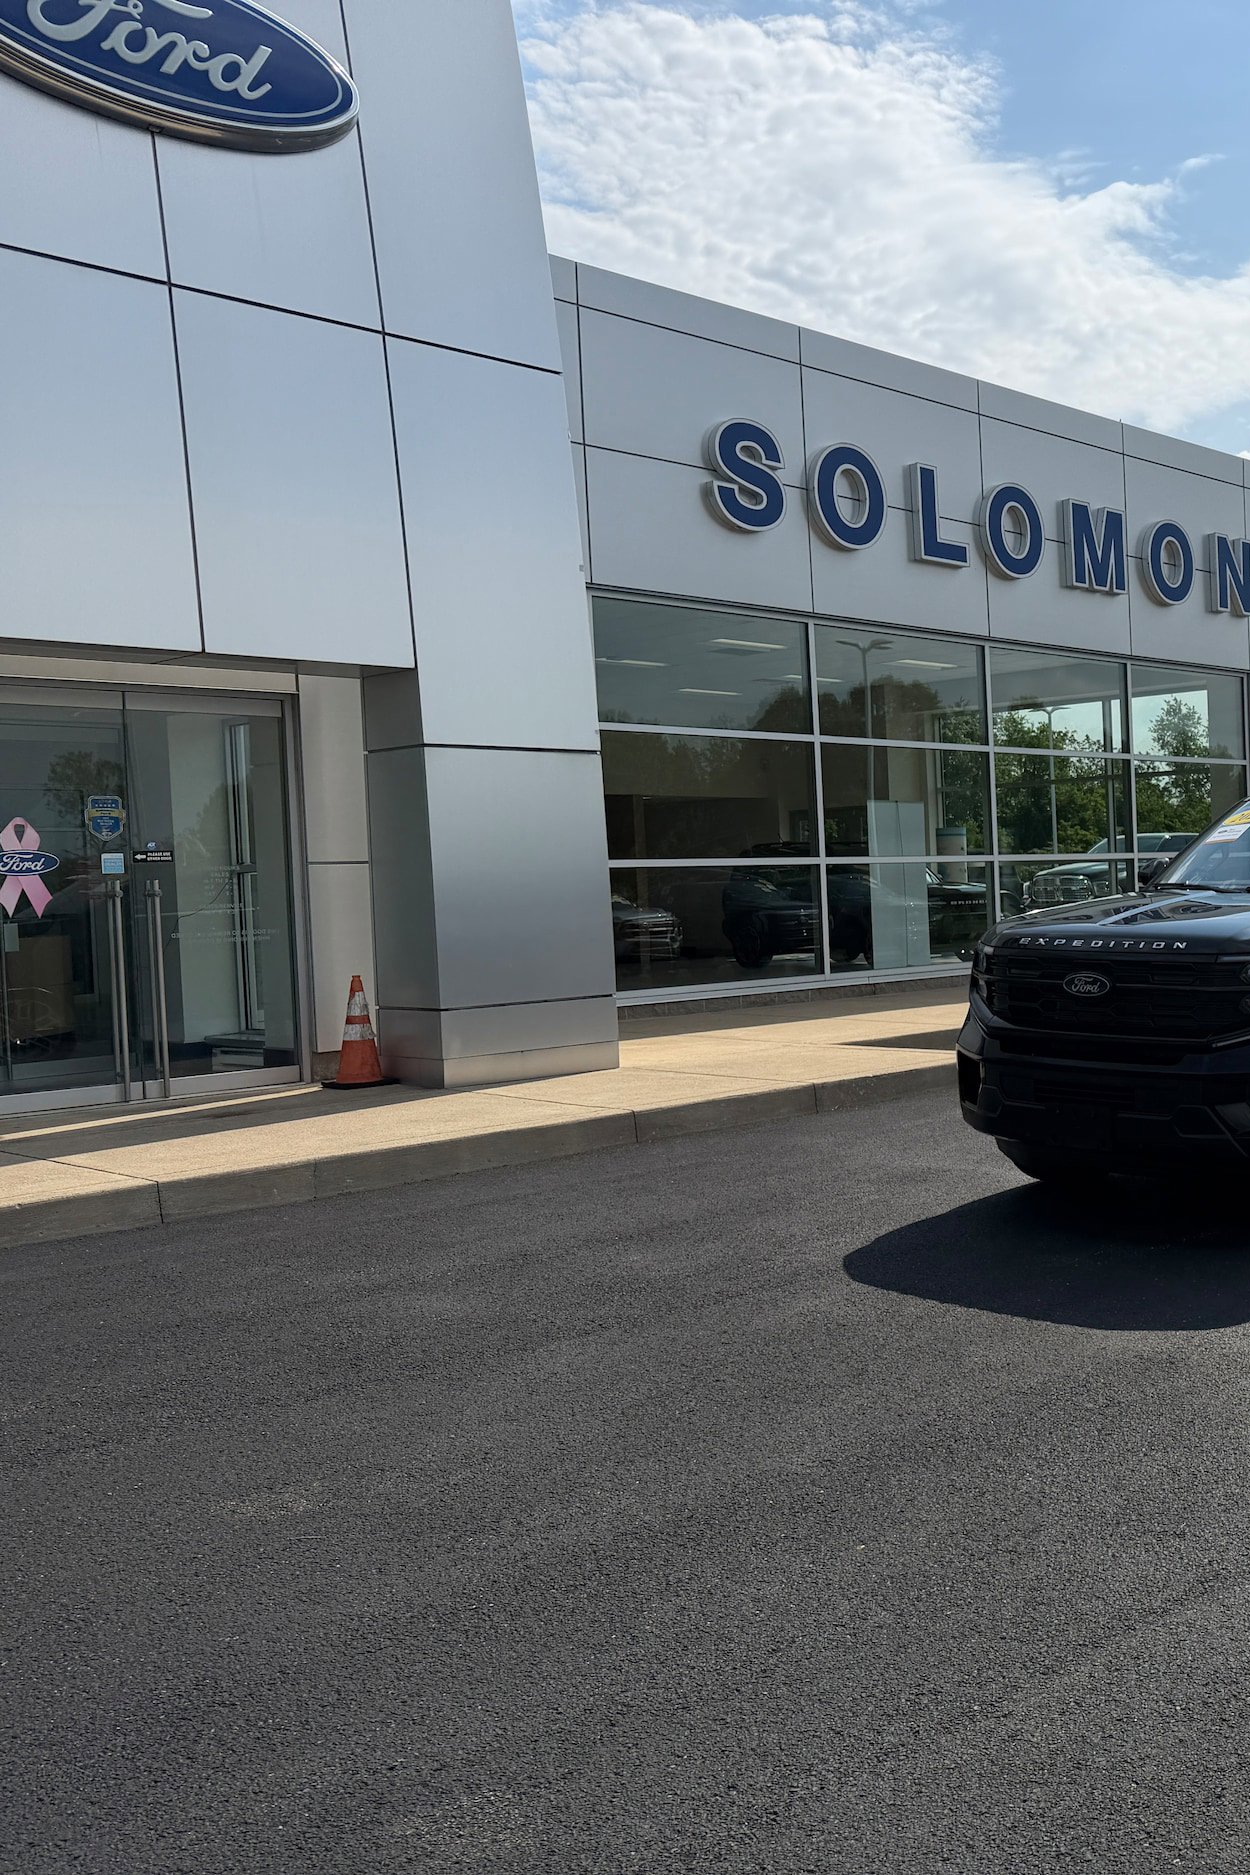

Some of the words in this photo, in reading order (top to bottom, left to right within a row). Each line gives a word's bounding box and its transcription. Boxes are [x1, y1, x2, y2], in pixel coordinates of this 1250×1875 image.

[0, 854, 45, 871] Ford
[1019, 937, 1187, 949] EXPEDITION
[1071, 976, 1100, 993] Ford
